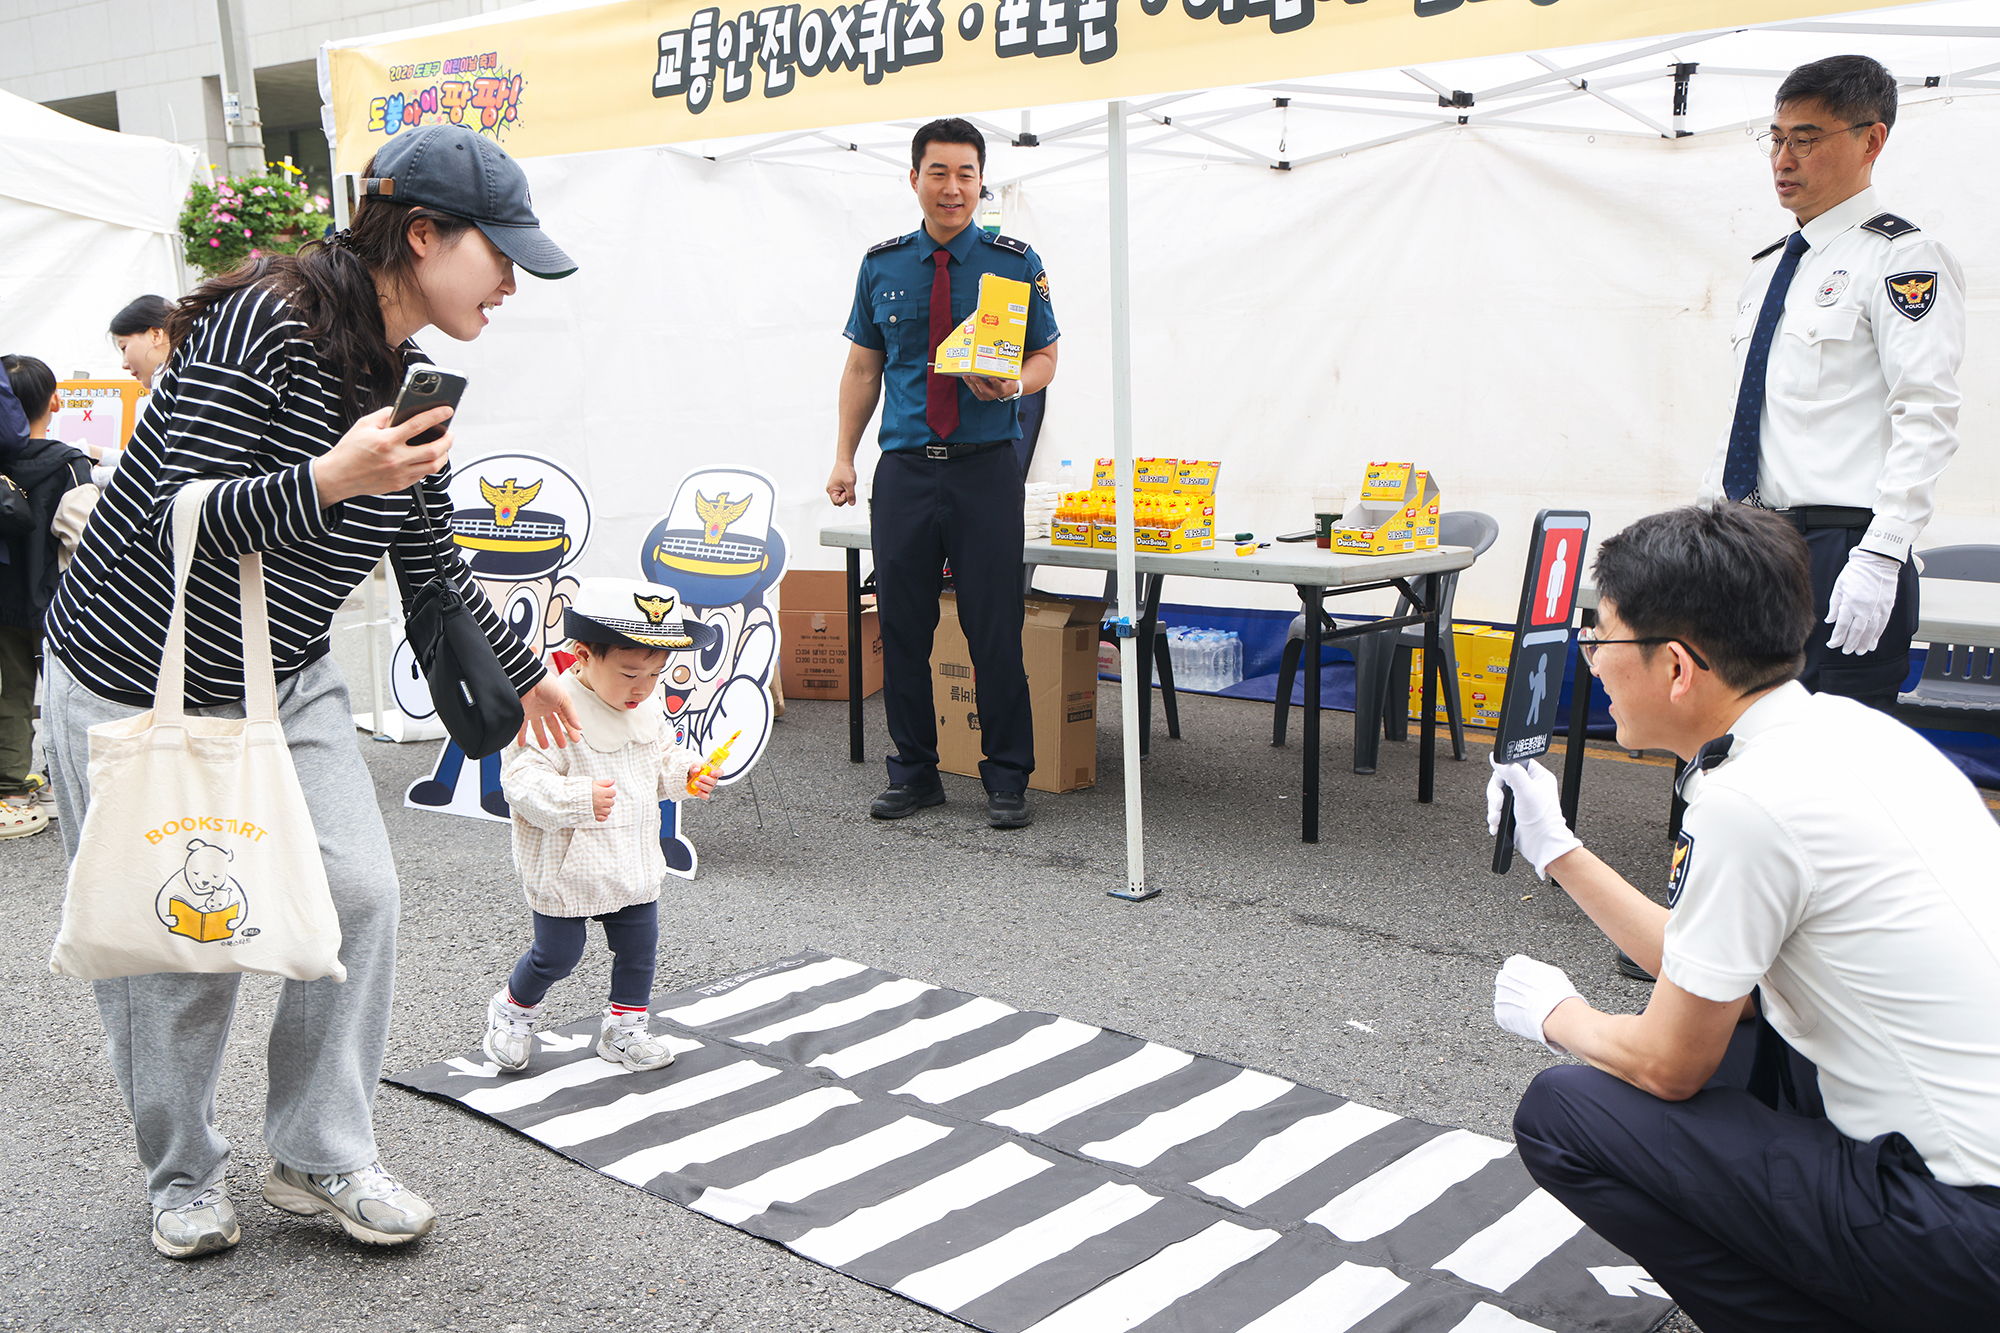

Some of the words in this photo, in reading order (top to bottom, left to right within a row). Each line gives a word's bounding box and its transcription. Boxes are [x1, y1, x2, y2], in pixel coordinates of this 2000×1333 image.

[390, 65, 414, 82] 2026
[413, 61, 441, 78] 도봉구
[443, 55, 478, 75] 어린이날
[479, 52, 497, 69] 축제
[654, 0, 941, 111] 교통안전OX퀴즈
[368, 85, 438, 135] 도봉아이
